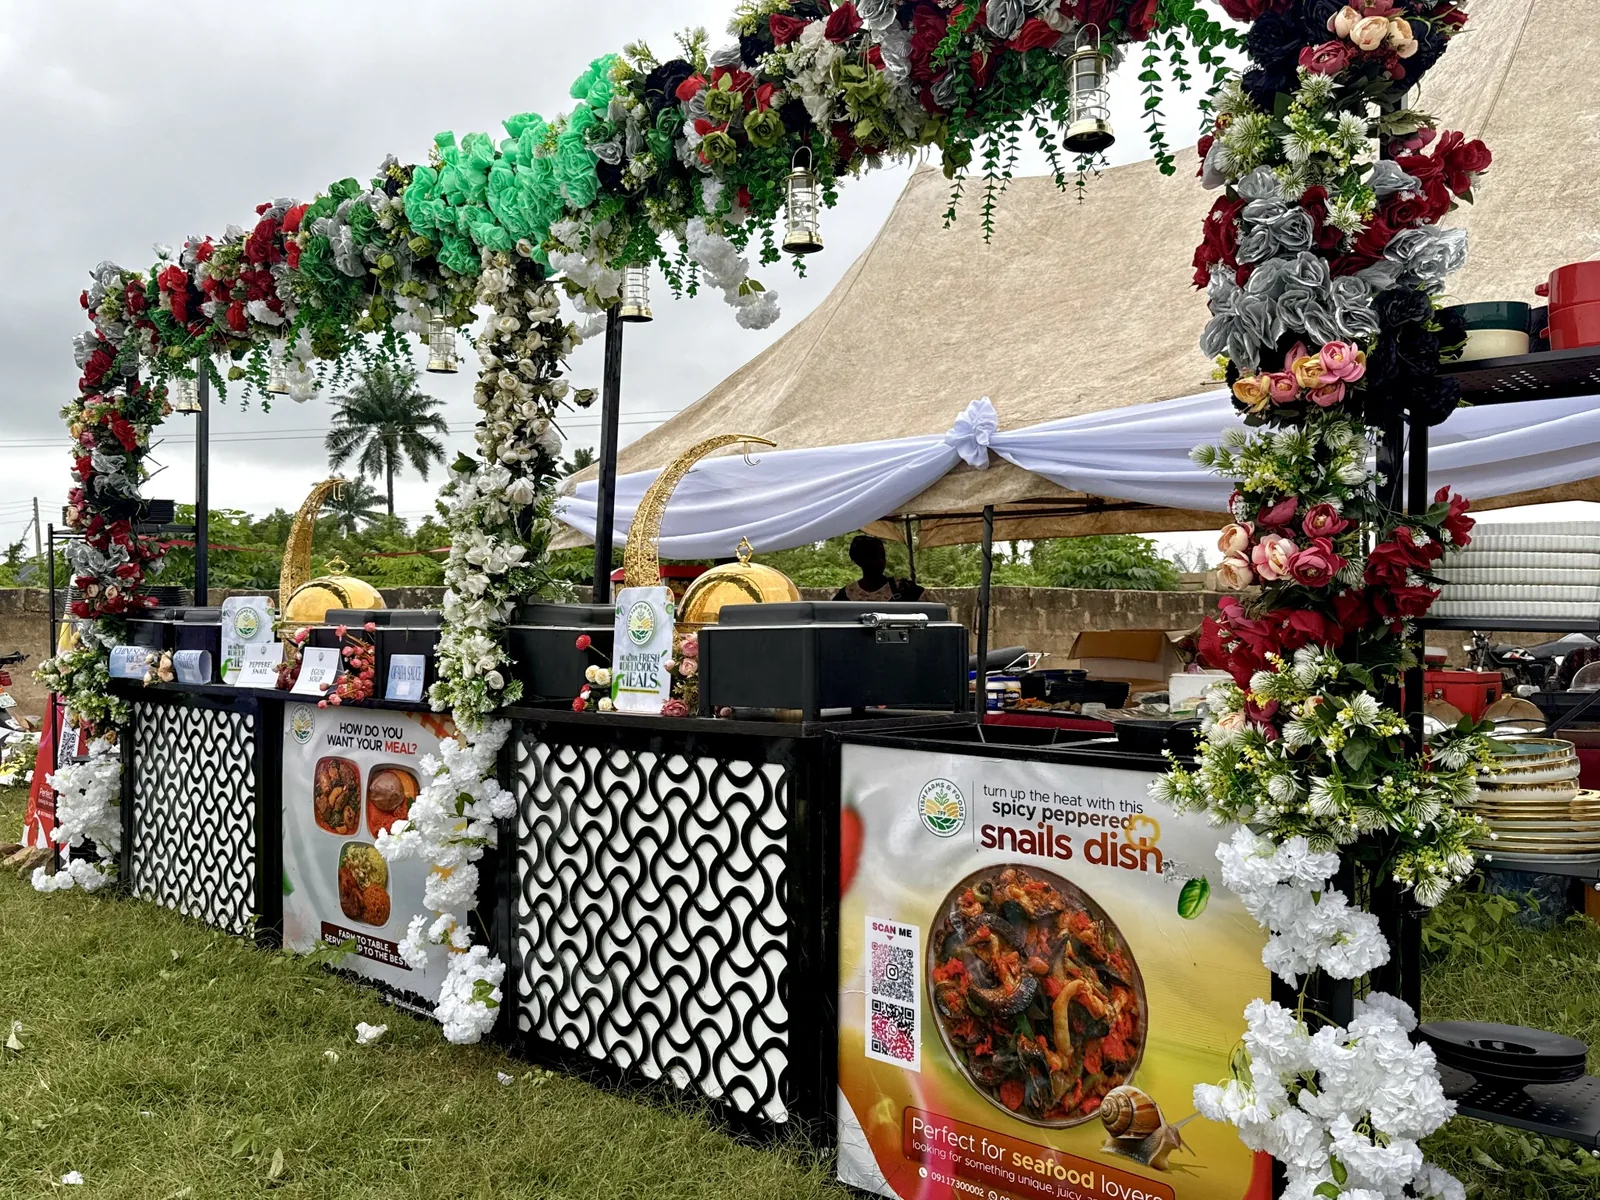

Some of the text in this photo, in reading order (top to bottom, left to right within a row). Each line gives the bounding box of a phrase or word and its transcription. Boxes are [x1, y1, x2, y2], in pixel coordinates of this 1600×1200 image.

[639, 653, 660, 663] FRESH
[618, 672, 658, 688] MEALS
[340, 722, 403, 740] HOW DO YOU
[327, 734, 418, 755] WANT YOUR MEAL?
[924, 782, 944, 795] FARMS
[952, 789, 964, 818] FOODS
[983, 784, 1144, 814] turn up the heat with this
[992, 799, 1133, 831] spicy peppered
[980, 821, 1073, 861] snails
[1084, 831, 1163, 874] dish
[872, 922, 912, 938] SCAN ME
[356, 935, 366, 945] TO
[367, 938, 391, 953] TABLE,
[364, 946, 374, 956] TO
[375, 949, 389, 961] THE
[912, 1116, 975, 1152] Perfect
[982, 1138, 1006, 1162] for
[1012, 1151, 1095, 1190] seafood
[912, 1139, 947, 1160] looking
[949, 1150, 962, 1164] for
[964, 1157, 1016, 1183] something
[1018, 1174, 1055, 1196] unique,
[931, 1171, 985, 1198] 09117300002
